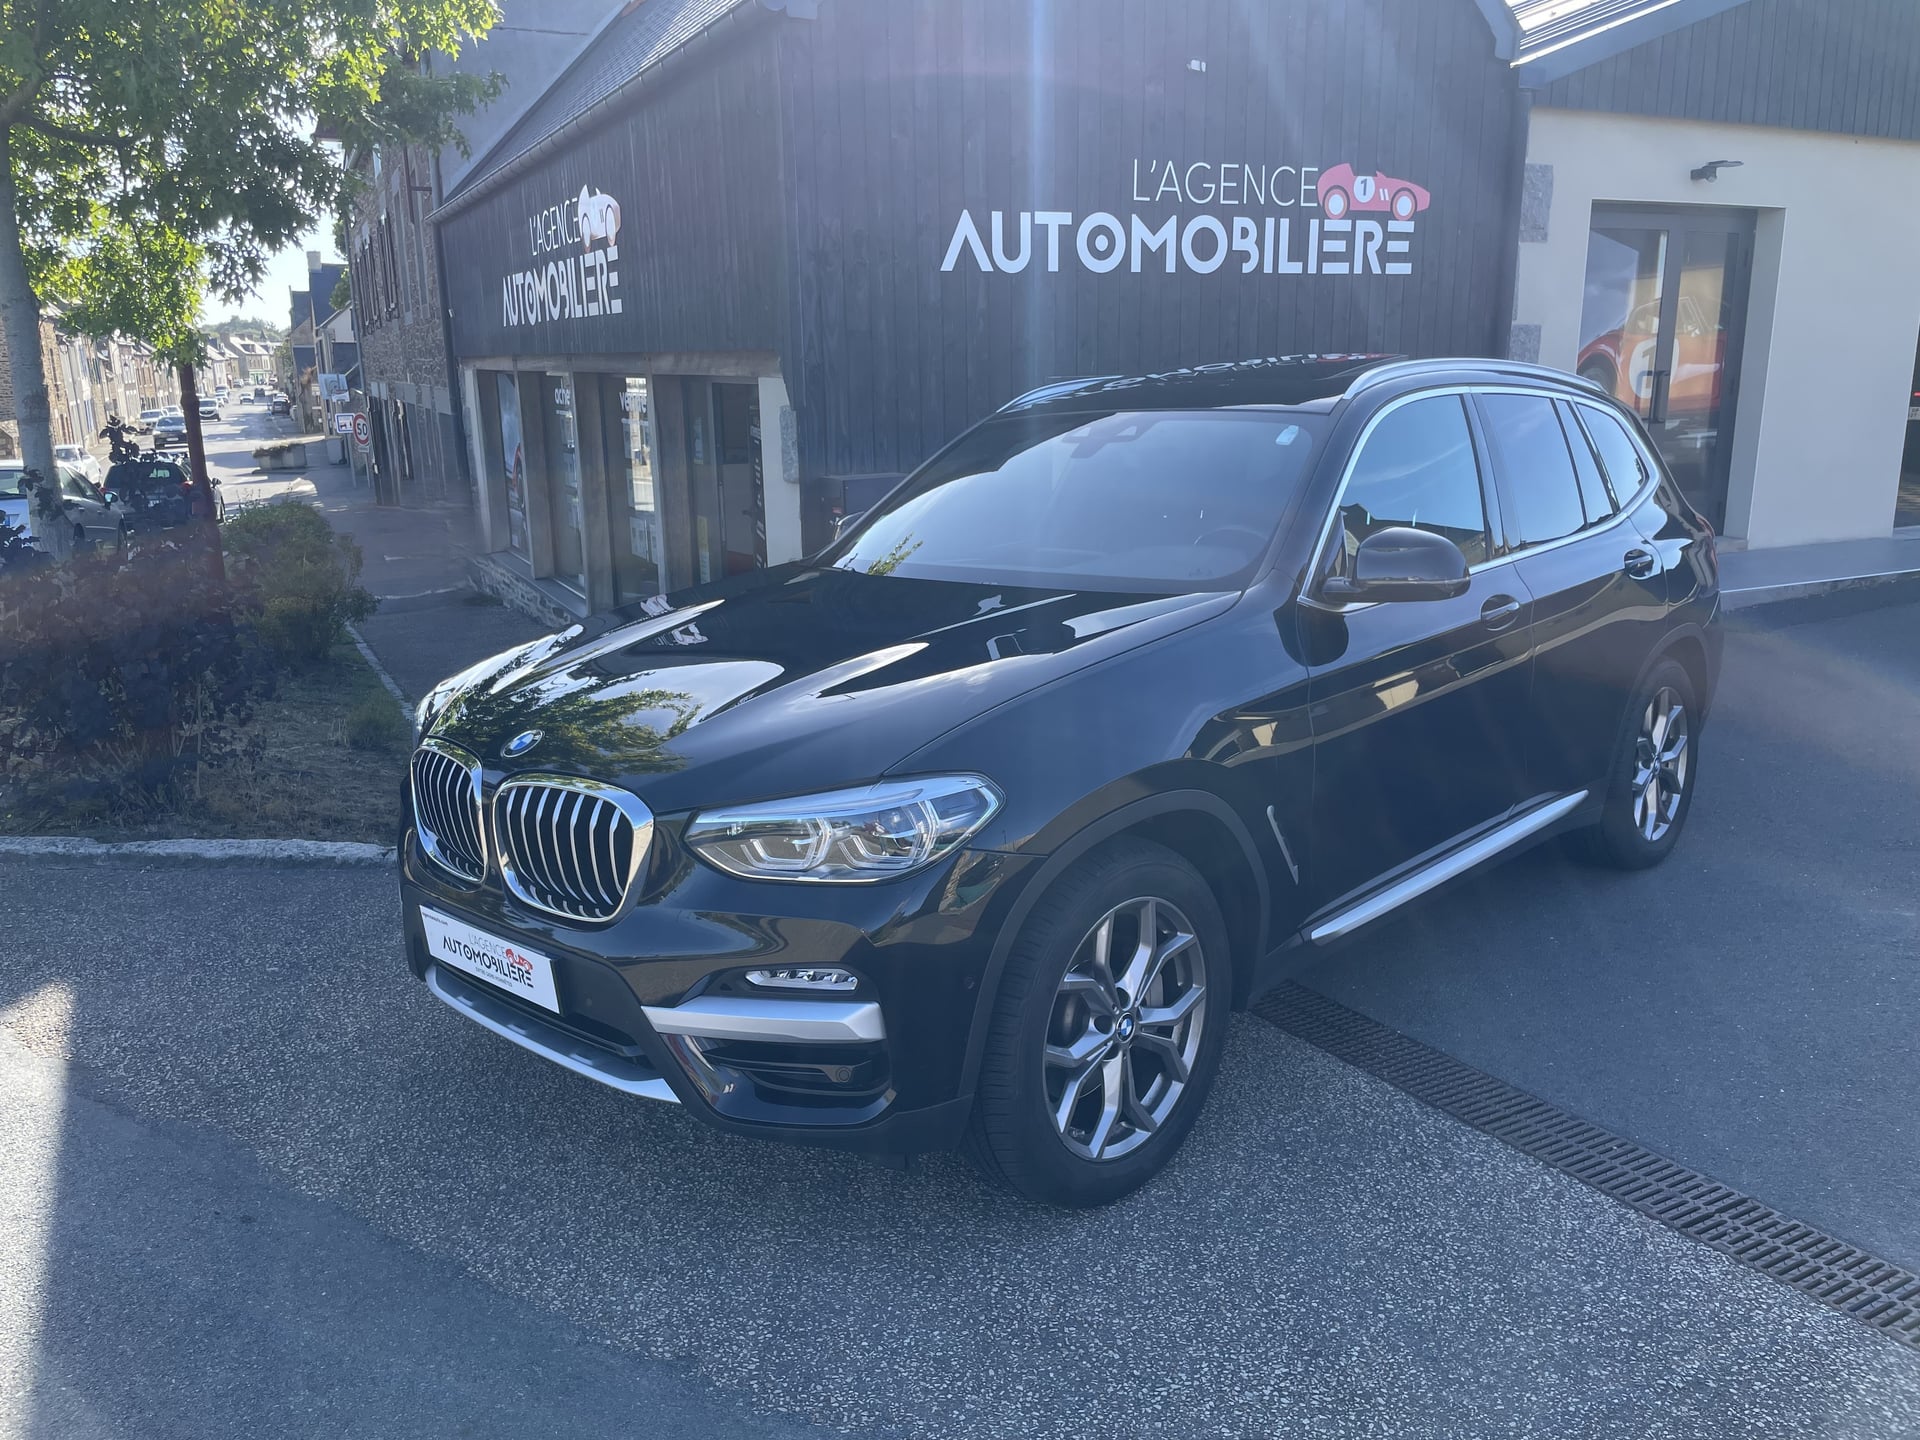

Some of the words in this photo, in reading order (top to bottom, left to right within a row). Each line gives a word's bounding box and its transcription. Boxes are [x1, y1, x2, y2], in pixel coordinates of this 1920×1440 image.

[1132, 158, 1318, 207] L'AGENCE
[1361, 178, 1368, 197] 1
[529, 198, 581, 256] L'AGENCE
[940, 209, 1415, 275] AUTOMOBILIERE
[503, 245, 623, 327] AUTOMOBILIERE
[356, 422, 368, 436] 50
[443, 935, 534, 988] AUTOMOBILIERE
[468, 932, 507, 959] L'AGENCE
